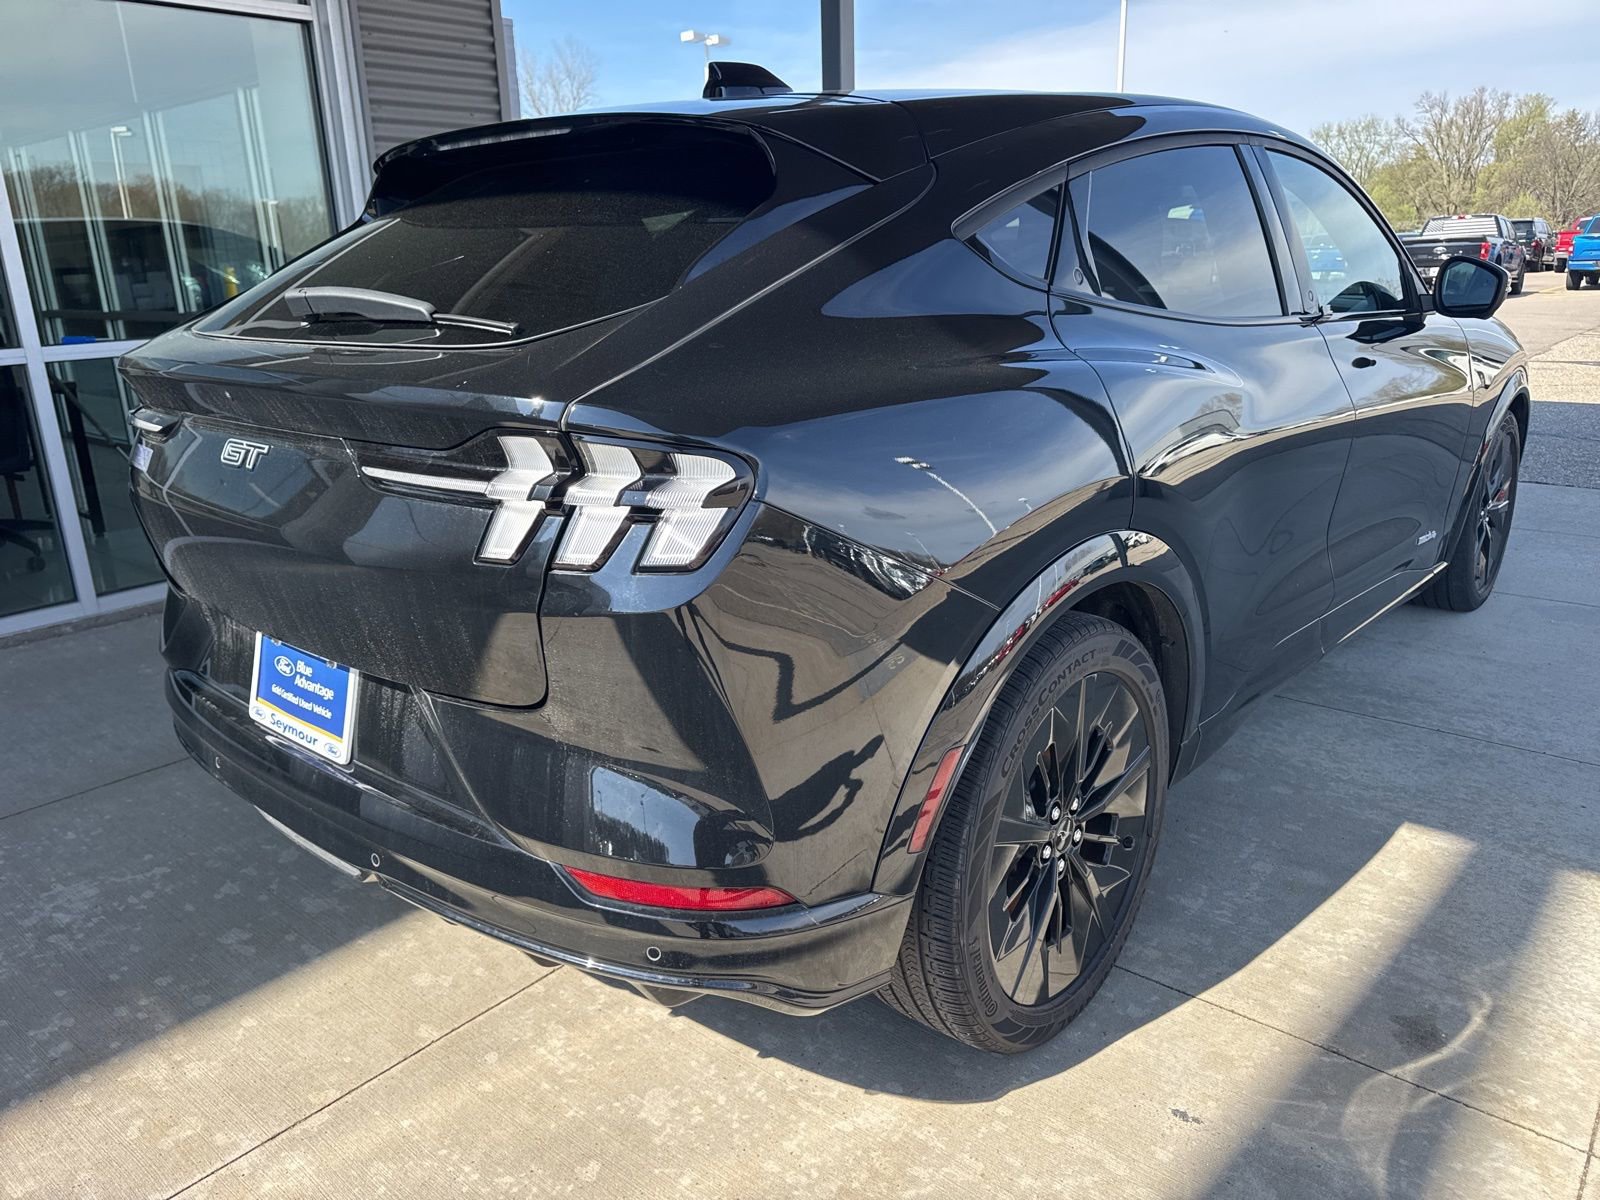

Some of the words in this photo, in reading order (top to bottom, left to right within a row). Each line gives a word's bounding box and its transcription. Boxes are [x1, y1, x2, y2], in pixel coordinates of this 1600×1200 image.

[220, 438, 270, 470] GT
[296, 660, 313, 677] Blue
[294, 674, 334, 700] Advantage
[299, 698, 313, 711] Used
[313, 703, 332, 719] Vehicle
[270, 712, 319, 746] Seymour
[969, 947, 998, 1017] Continental
